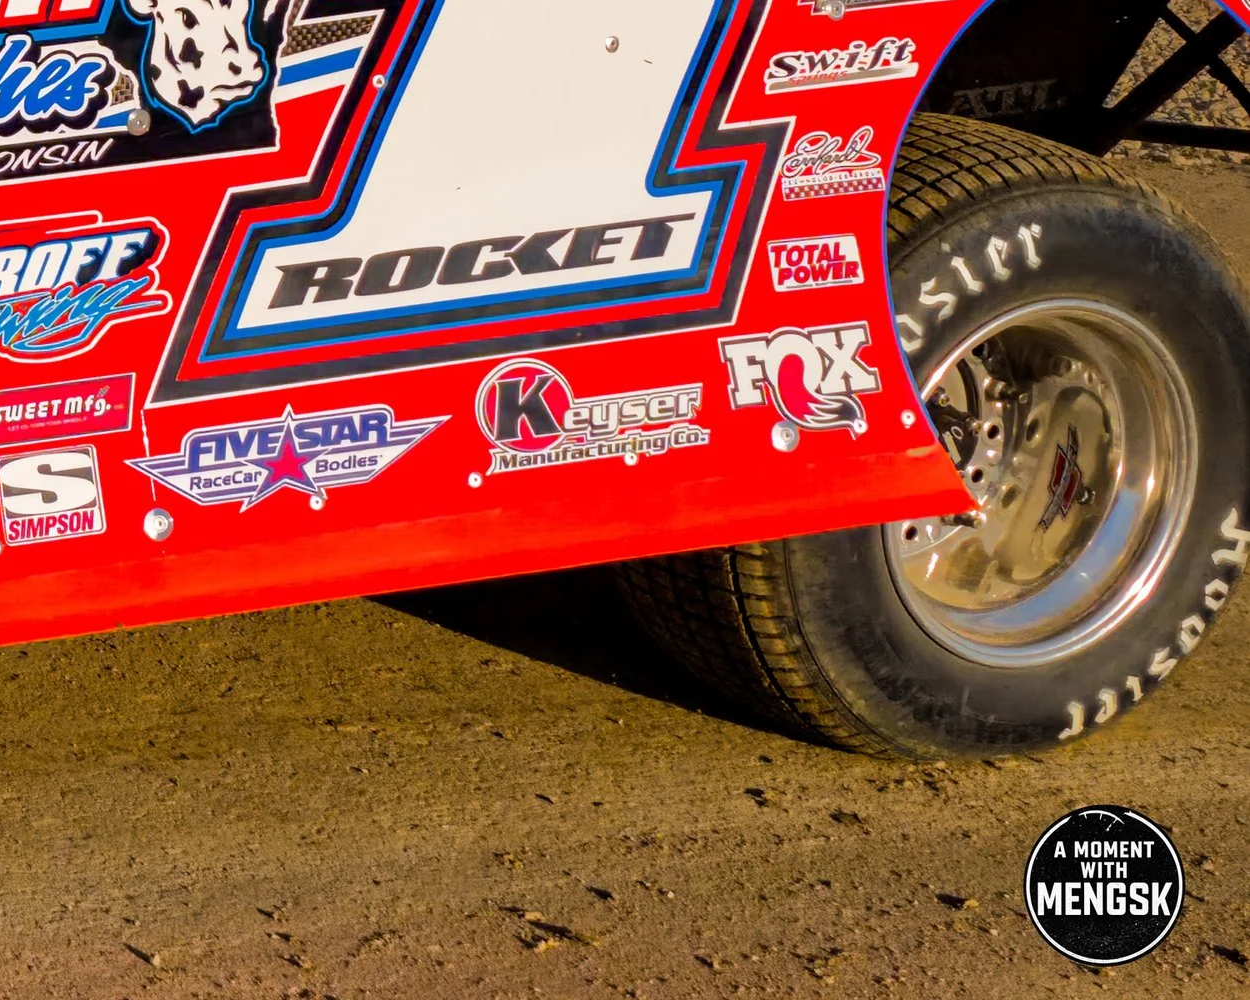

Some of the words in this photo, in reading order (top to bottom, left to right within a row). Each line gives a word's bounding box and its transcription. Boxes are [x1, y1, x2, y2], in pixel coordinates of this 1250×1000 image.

[267, 212, 696, 310] ROCKET
[770, 242, 846, 268] TOTAL
[777, 260, 860, 286] POWER
[722, 323, 881, 412] FOX
[64, 394, 111, 417] Mfg.
[495, 375, 699, 442] Keyser
[188, 430, 282, 472] FIVE
[294, 412, 389, 450] STAR
[498, 436, 668, 471] Manufacturing
[673, 429, 707, 446] Co.
[0, 448, 97, 517] S
[190, 470, 262, 491] RaceCar
[315, 454, 379, 474] Bodies
[8, 511, 95, 541] SIMPSON
